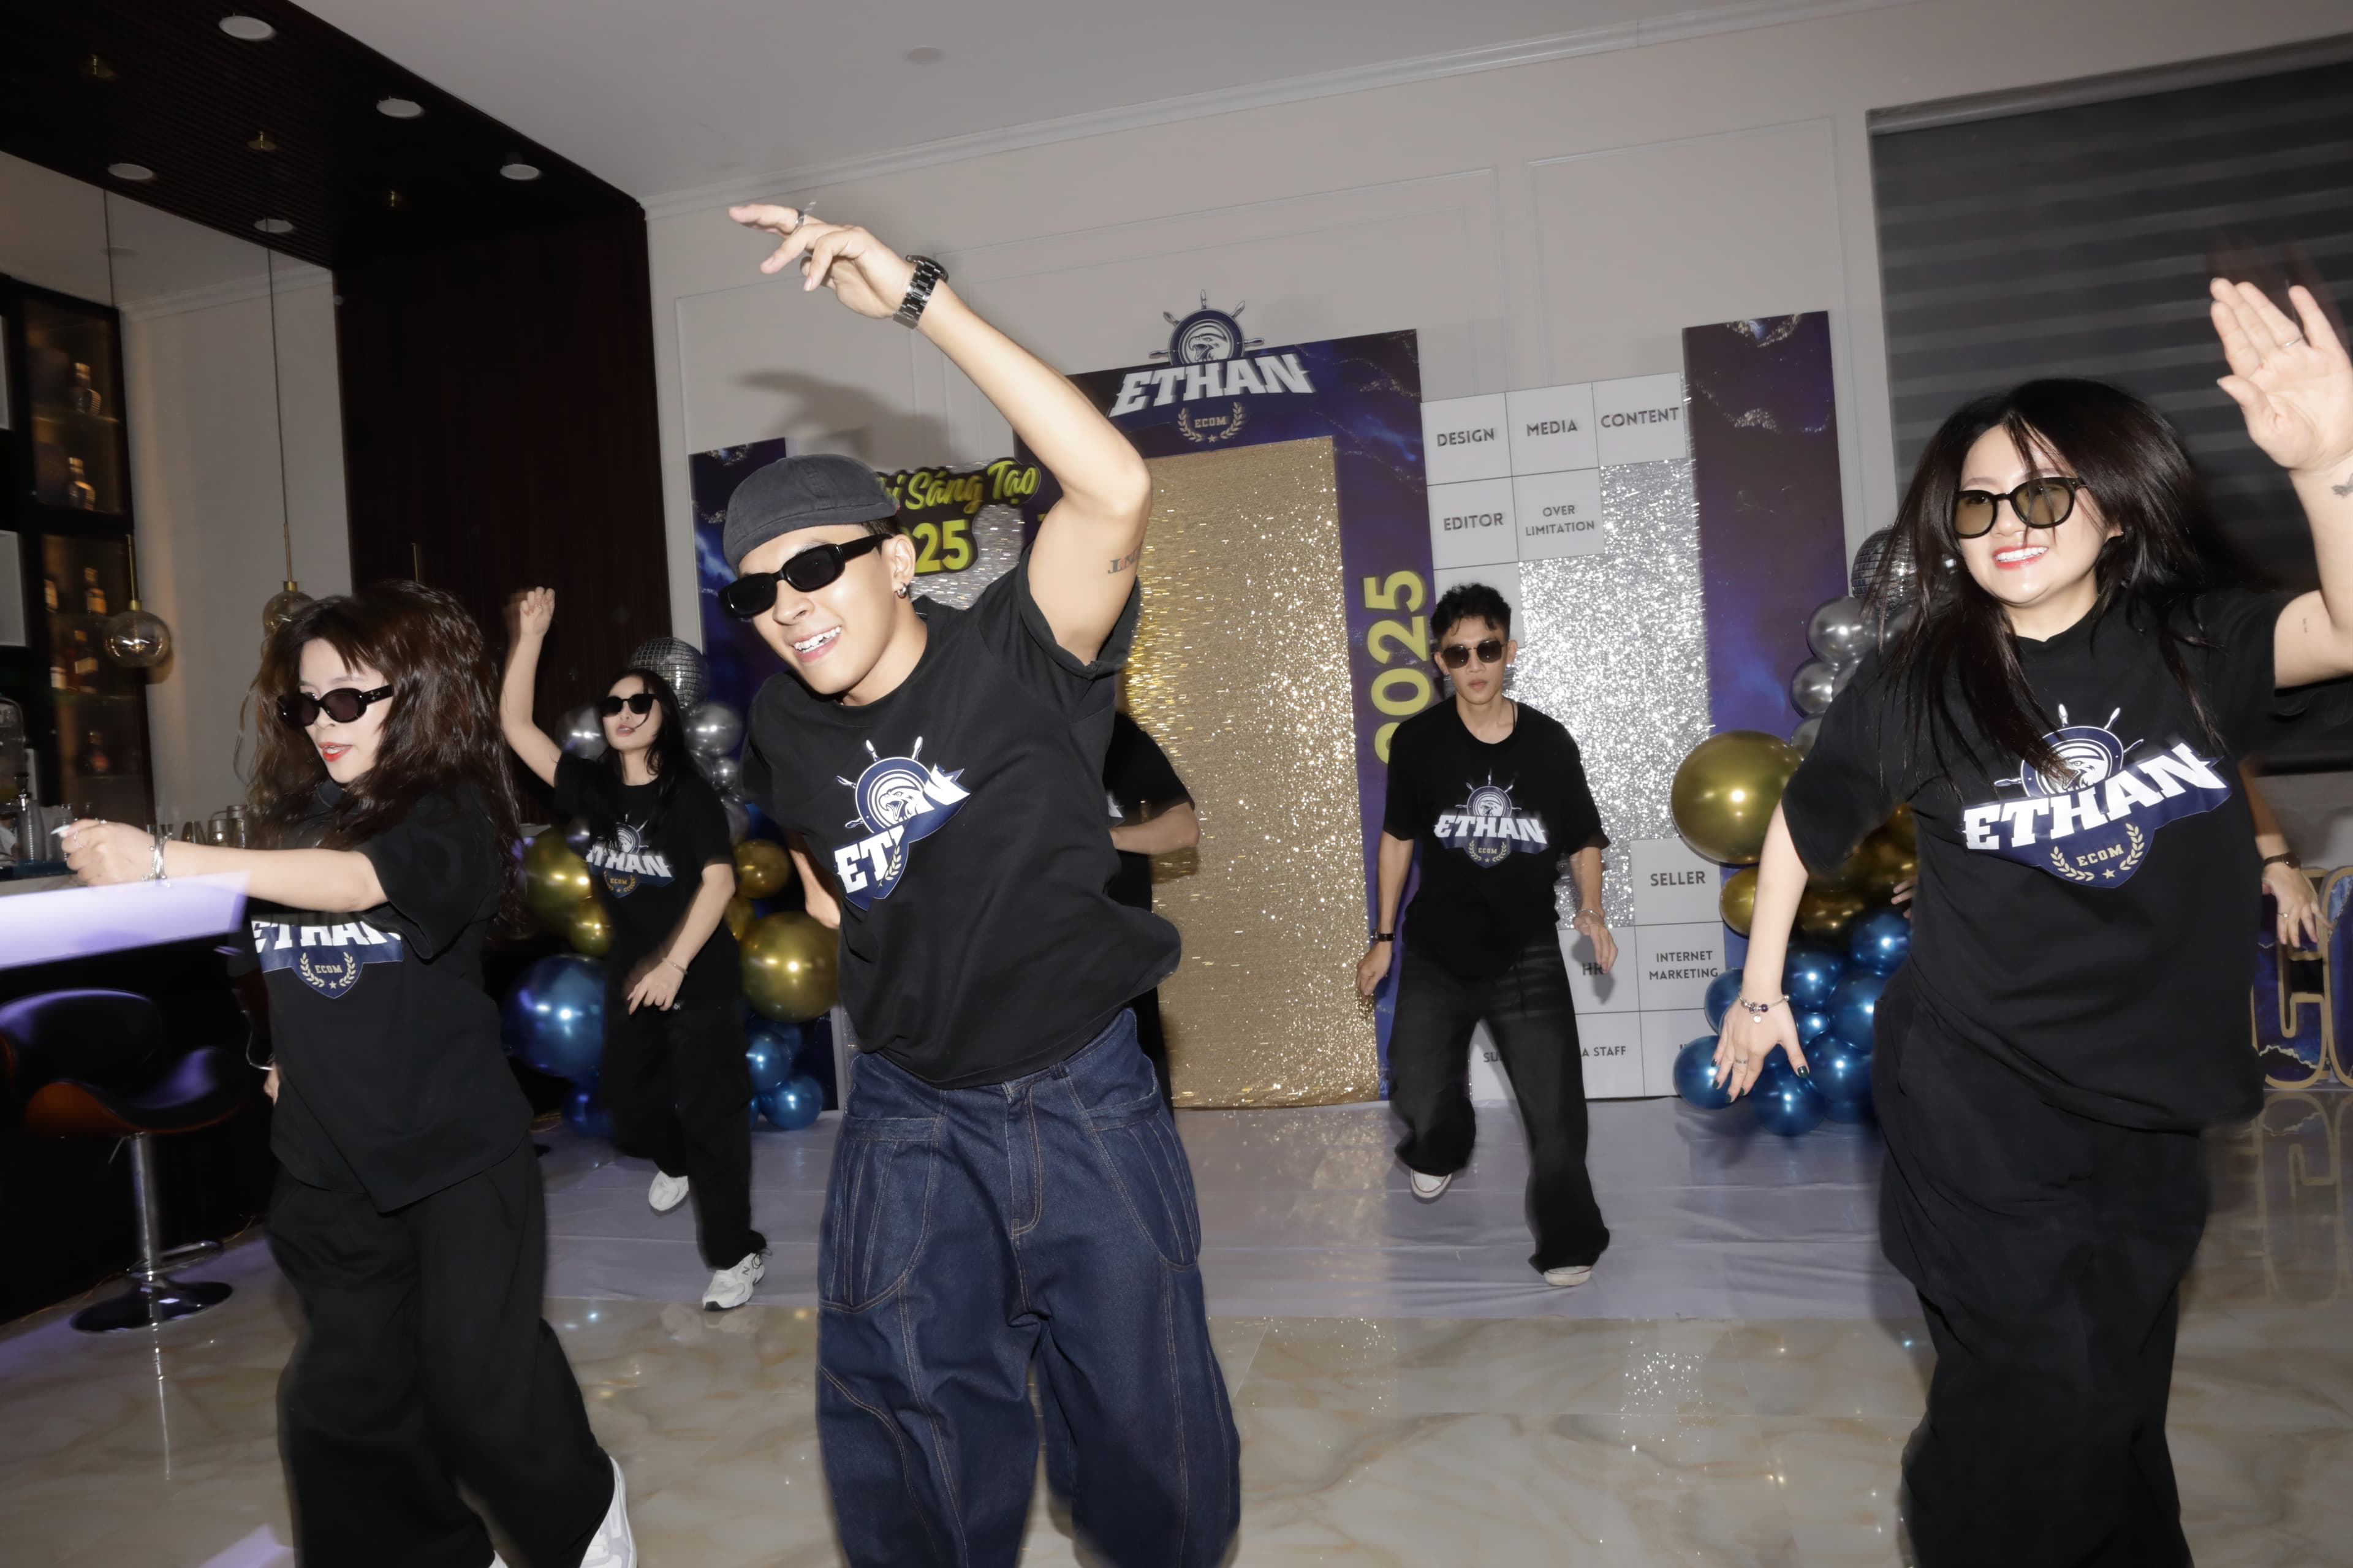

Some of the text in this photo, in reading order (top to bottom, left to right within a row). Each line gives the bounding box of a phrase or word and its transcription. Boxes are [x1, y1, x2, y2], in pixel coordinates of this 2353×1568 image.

[1108, 353, 1316, 417] ETHAN
[1194, 416, 1227, 428] ECOM
[1600, 407, 1679, 428] CONTENT
[1526, 419, 1578, 436] MEDIA
[1436, 428, 1495, 447] DESIGN
[905, 470, 982, 514] Sáng
[987, 460, 1039, 504] Tạo
[1542, 504, 1575, 517] OVER
[1444, 512, 1504, 531] EDITOR
[1526, 520, 1595, 536] LIMITATION
[1963, 742, 2227, 850] ETHAN
[1434, 814, 1547, 844] ETHAN
[2077, 844, 2124, 866] ECOM
[1650, 871, 1706, 887] SELLER
[1656, 950, 1713, 963] INTERNET
[315, 964, 343, 974] ECOM
[1649, 968, 1718, 980] MARKETING
[1593, 1045, 1626, 1057] STAFF
